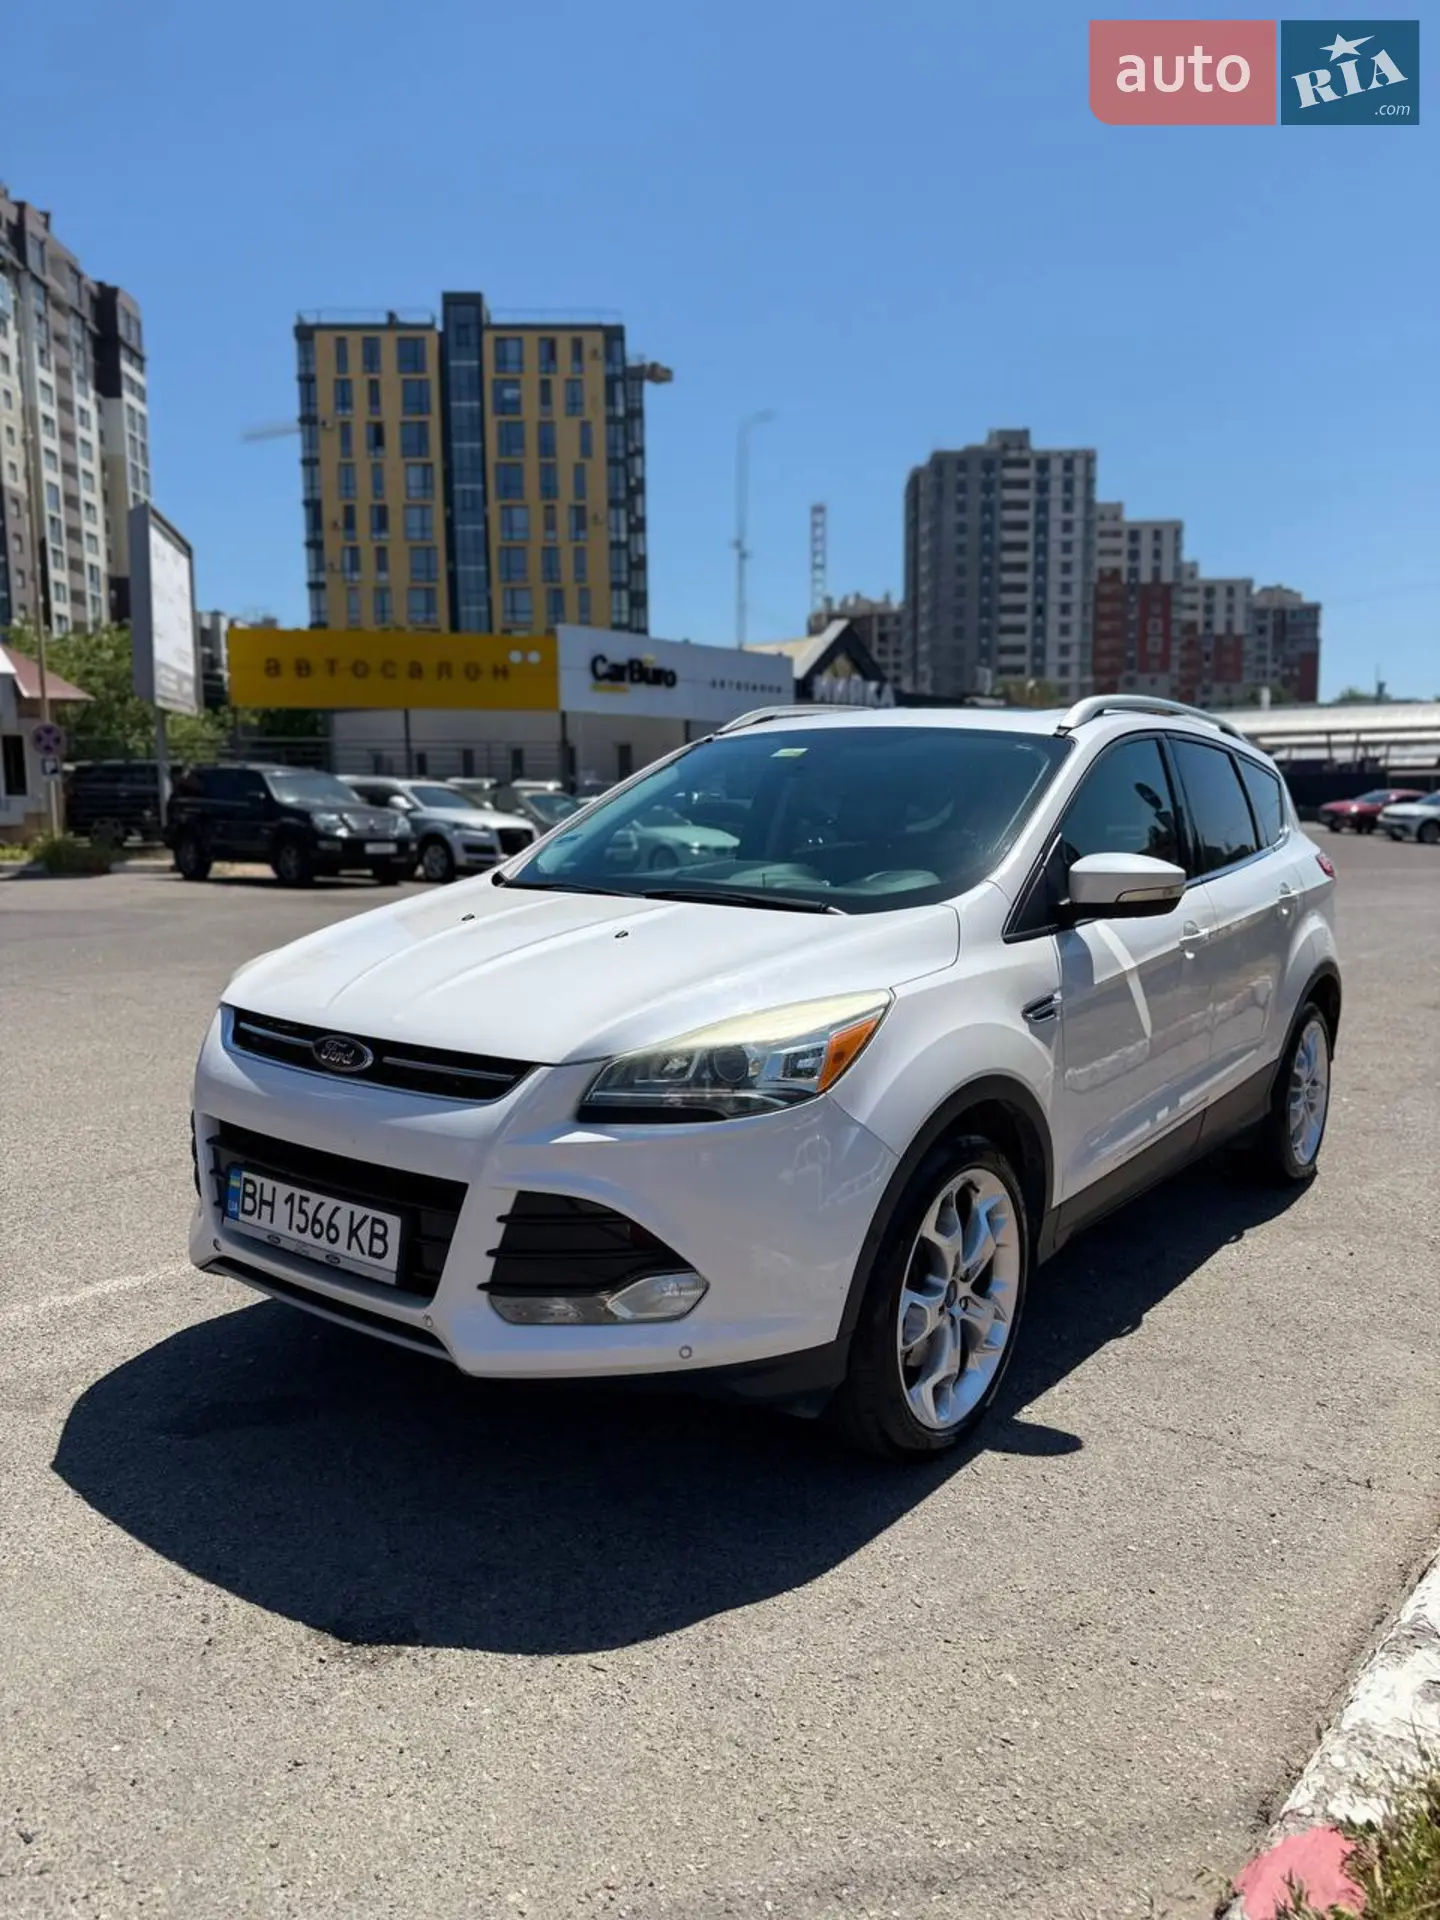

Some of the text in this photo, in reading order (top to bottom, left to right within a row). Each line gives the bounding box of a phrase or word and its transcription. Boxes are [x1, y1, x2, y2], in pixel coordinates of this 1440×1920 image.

[264, 656, 511, 681] автосалон
[321, 1040, 355, 1065] Ford
[241, 1177, 389, 1260] BH 1566 KB
